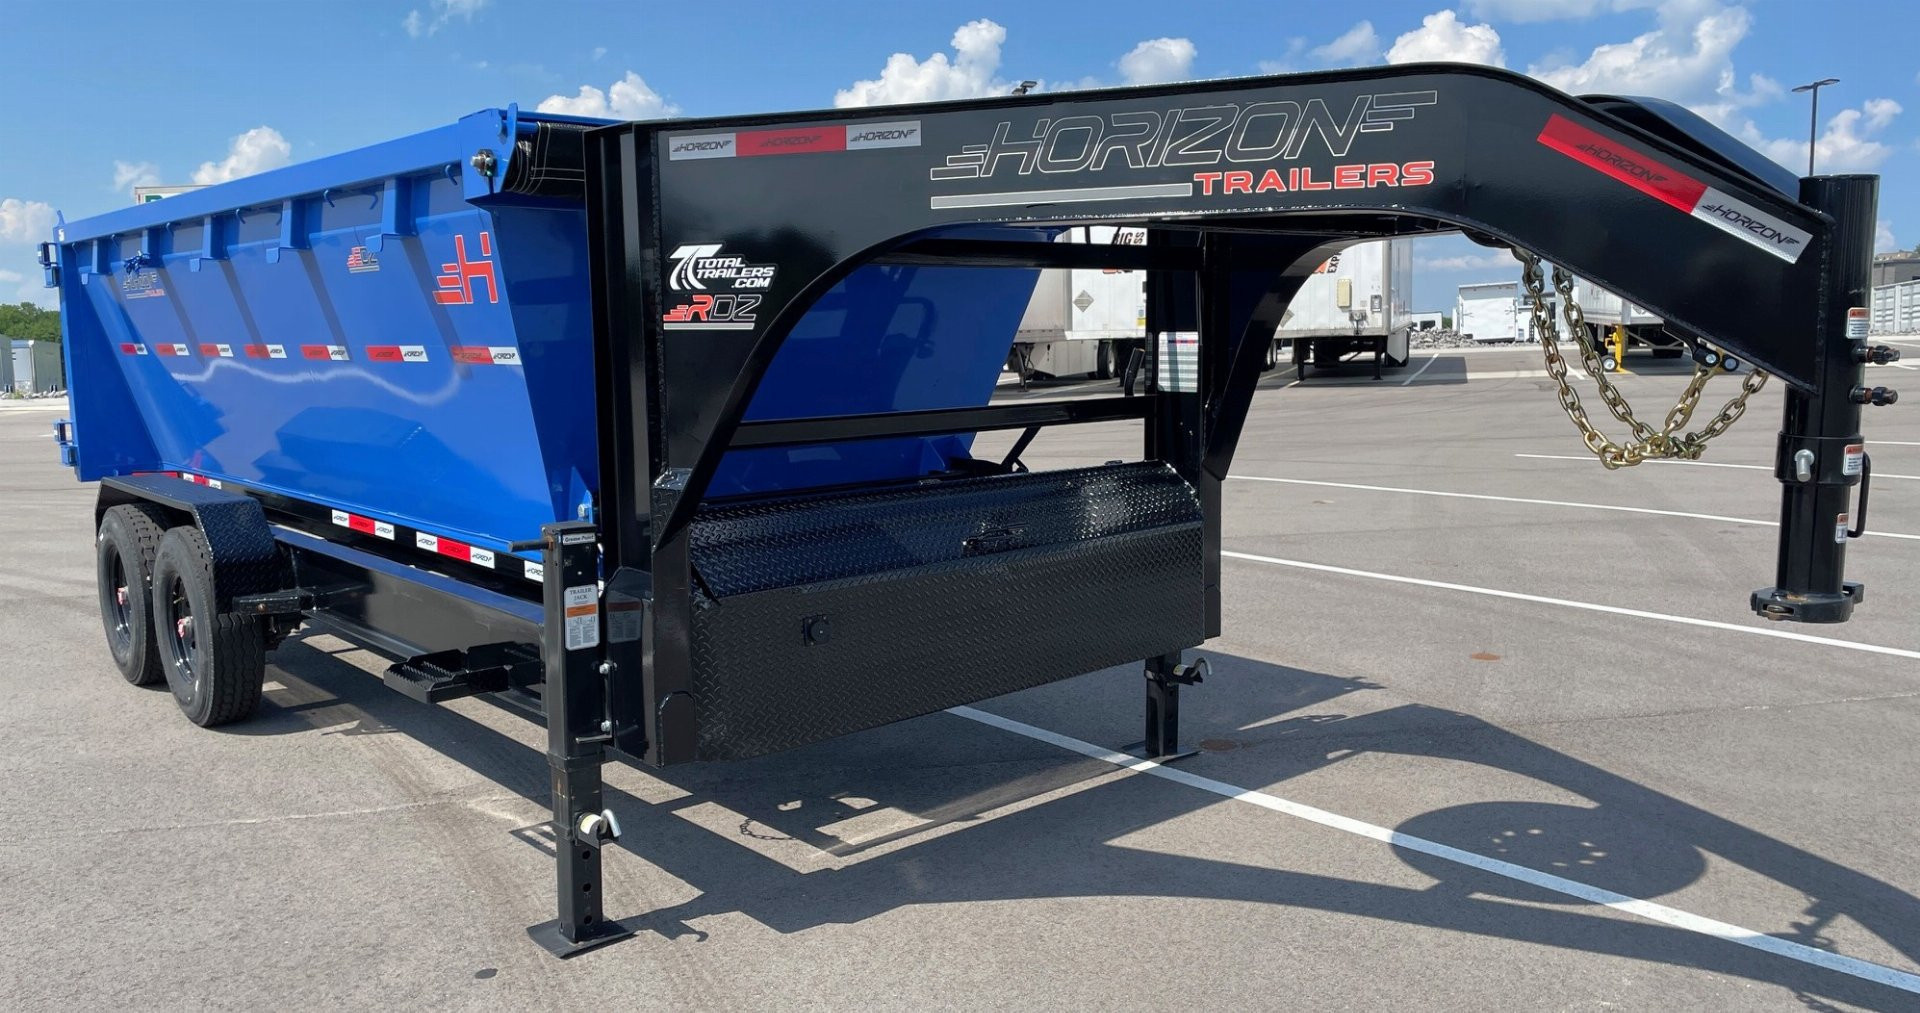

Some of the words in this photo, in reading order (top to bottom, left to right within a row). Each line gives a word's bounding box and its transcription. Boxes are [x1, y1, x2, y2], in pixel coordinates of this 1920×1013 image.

[767, 135, 815, 148] HORIZON
[857, 130, 910, 142] HORIZON
[976, 96, 1376, 178] HORIZON
[678, 140, 727, 152] HORIZON
[1584, 143, 1660, 183] HORIZON
[1194, 161, 1435, 196] TRAILERS
[1712, 204, 1791, 245] HORIZON
[697, 257, 746, 269] TOTAL
[696, 266, 776, 279] TRAILERS
[731, 277, 771, 288] .COM
[682, 294, 762, 321] RDZ
[569, 587, 592, 596] TRAILER
